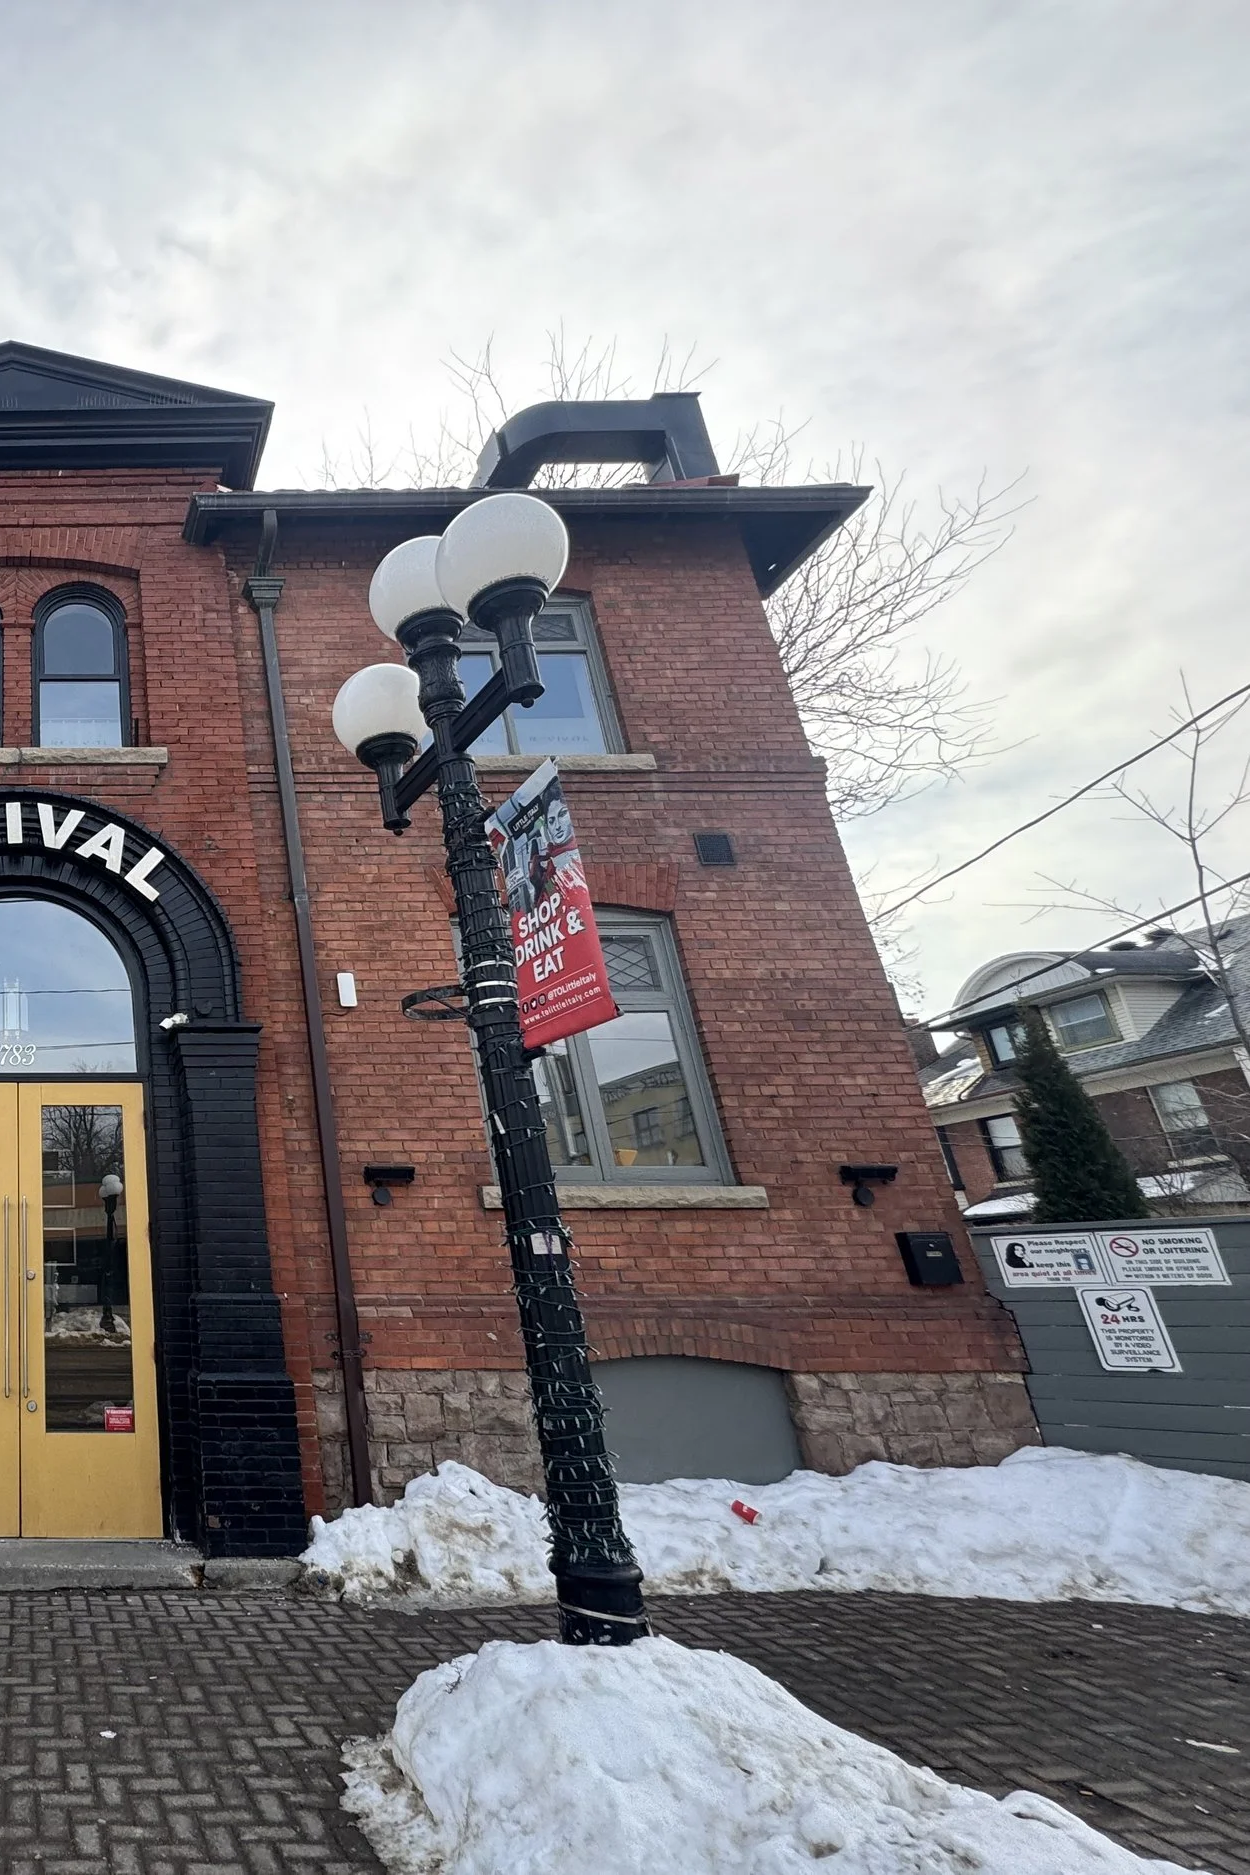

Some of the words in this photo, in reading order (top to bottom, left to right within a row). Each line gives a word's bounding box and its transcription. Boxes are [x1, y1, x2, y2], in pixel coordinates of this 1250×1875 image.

[513, 814, 528, 831] LITTLE
[518, 892, 566, 938] SHOP,
[515, 918, 565, 968] DRINK
[566, 909, 585, 935] &
[532, 946, 564, 982] EAT
[547, 972, 597, 1001] @TOLittleItaly
[0, 1044, 36, 1066] 783
[1101, 1313, 1120, 1324] 24
